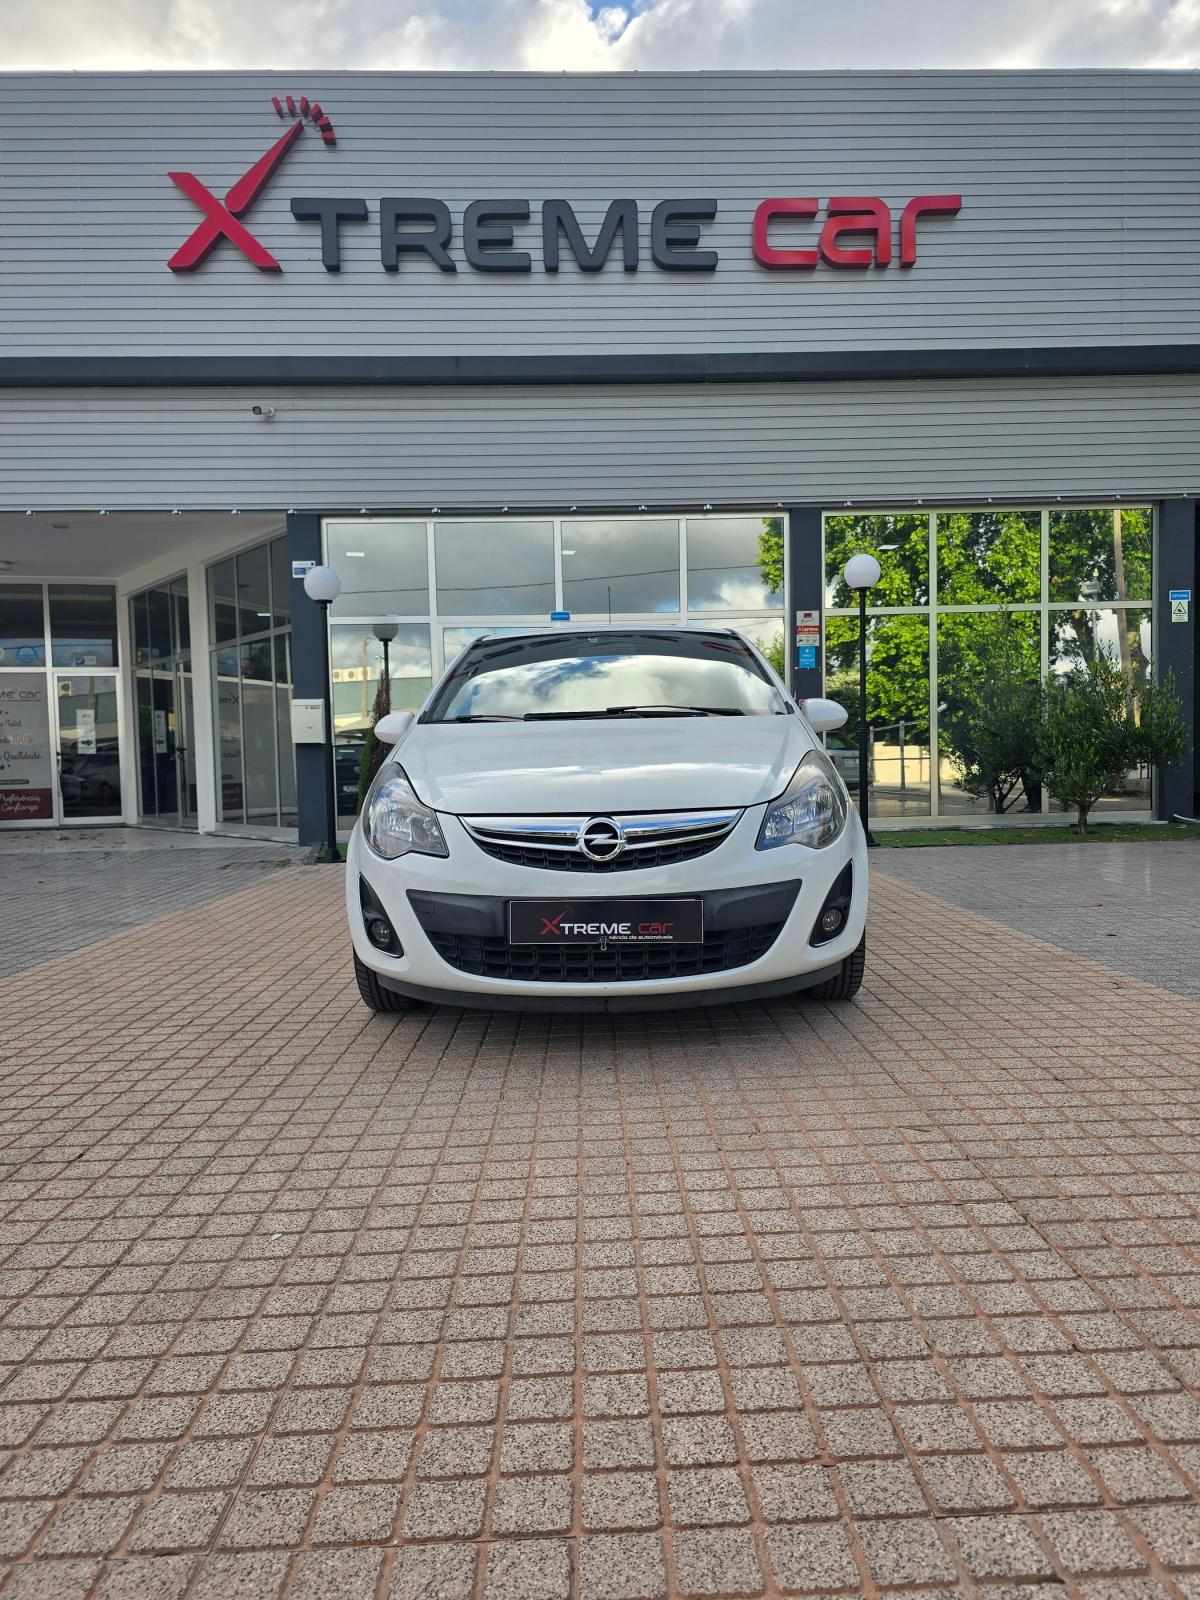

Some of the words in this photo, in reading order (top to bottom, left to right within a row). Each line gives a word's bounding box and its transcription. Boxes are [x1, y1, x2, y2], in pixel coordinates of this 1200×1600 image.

[167, 118, 718, 274] XTREME
[752, 195, 962, 272] car
[540, 911, 631, 935] XTREME
[639, 922, 672, 934] car
